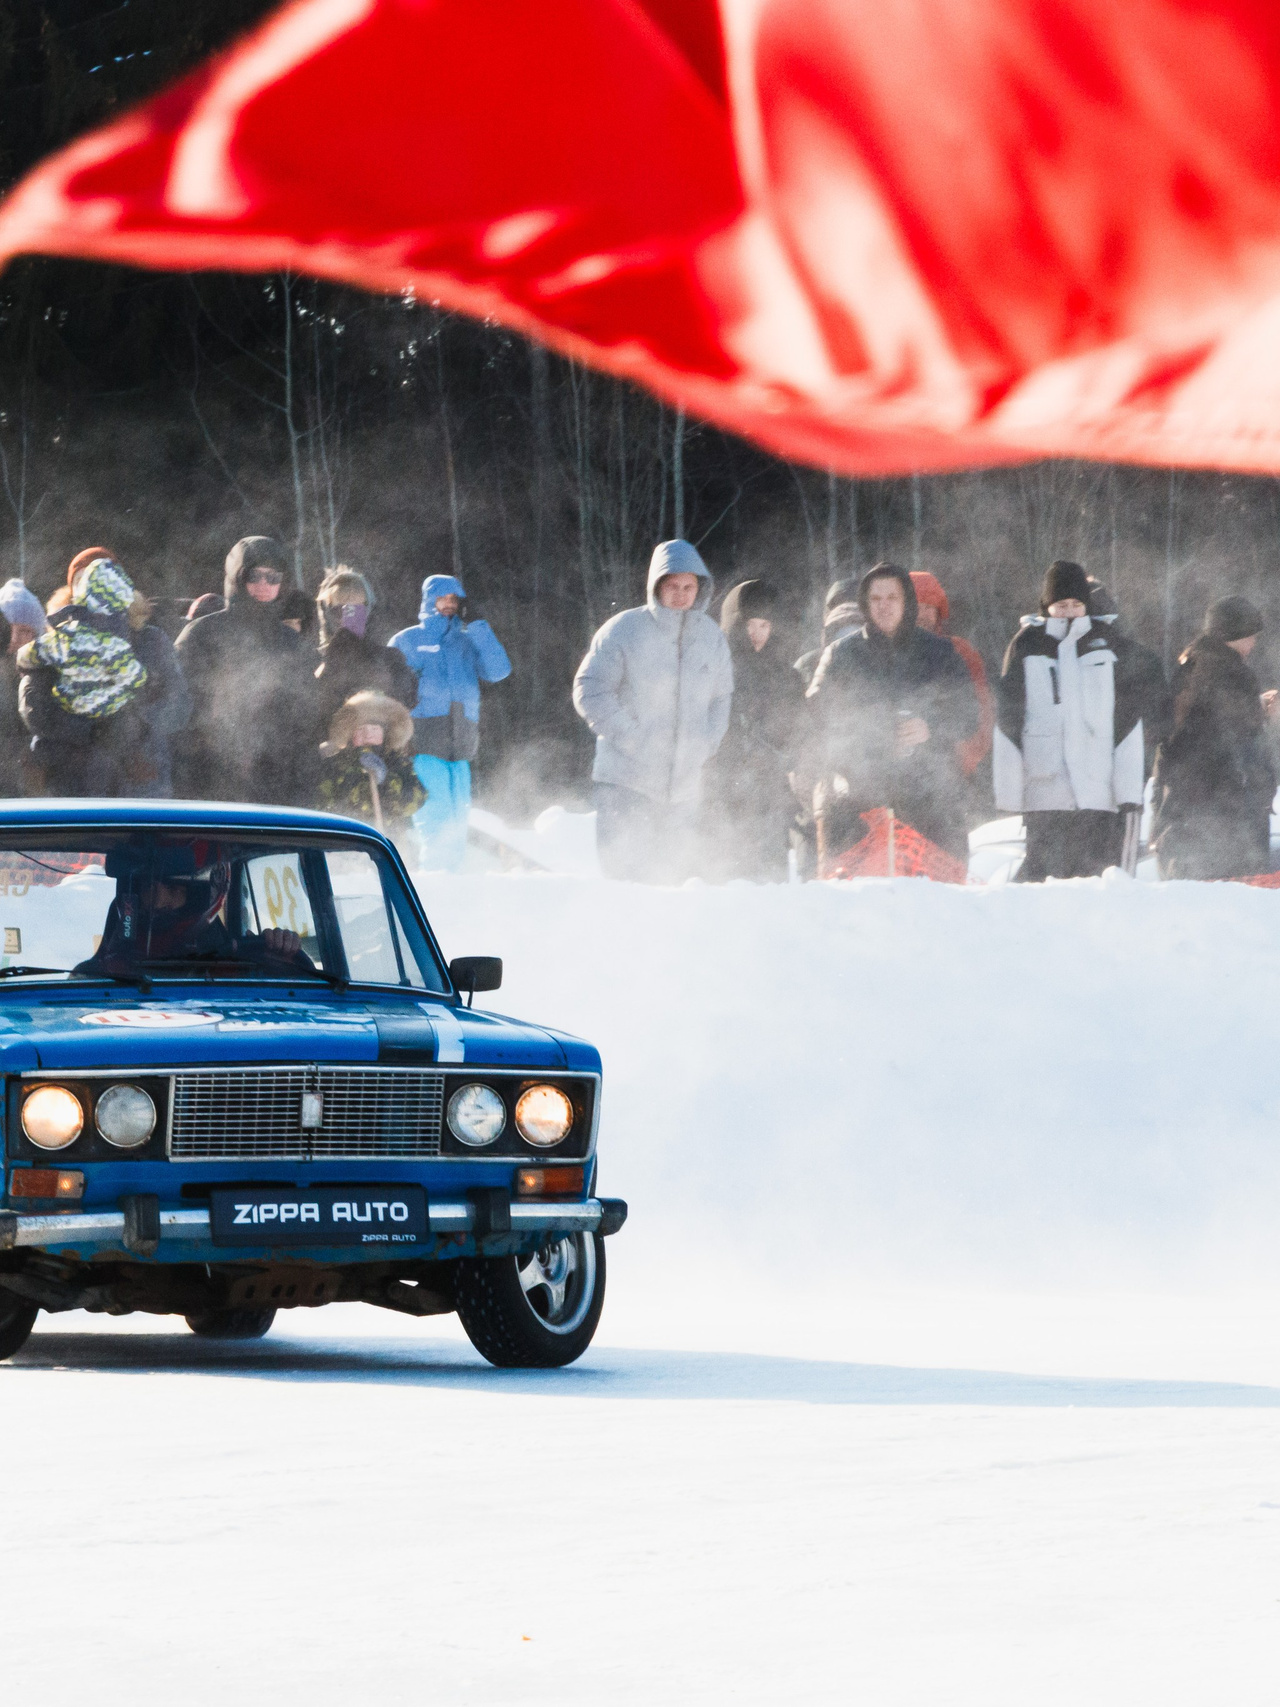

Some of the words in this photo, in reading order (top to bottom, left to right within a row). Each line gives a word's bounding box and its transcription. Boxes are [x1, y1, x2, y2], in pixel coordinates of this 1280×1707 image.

[232, 1203, 320, 1224] ZIPPA
[332, 1202, 409, 1222] AUTO
[361, 1234, 389, 1242] ZIPPA
[392, 1234, 417, 1242] AUTO
